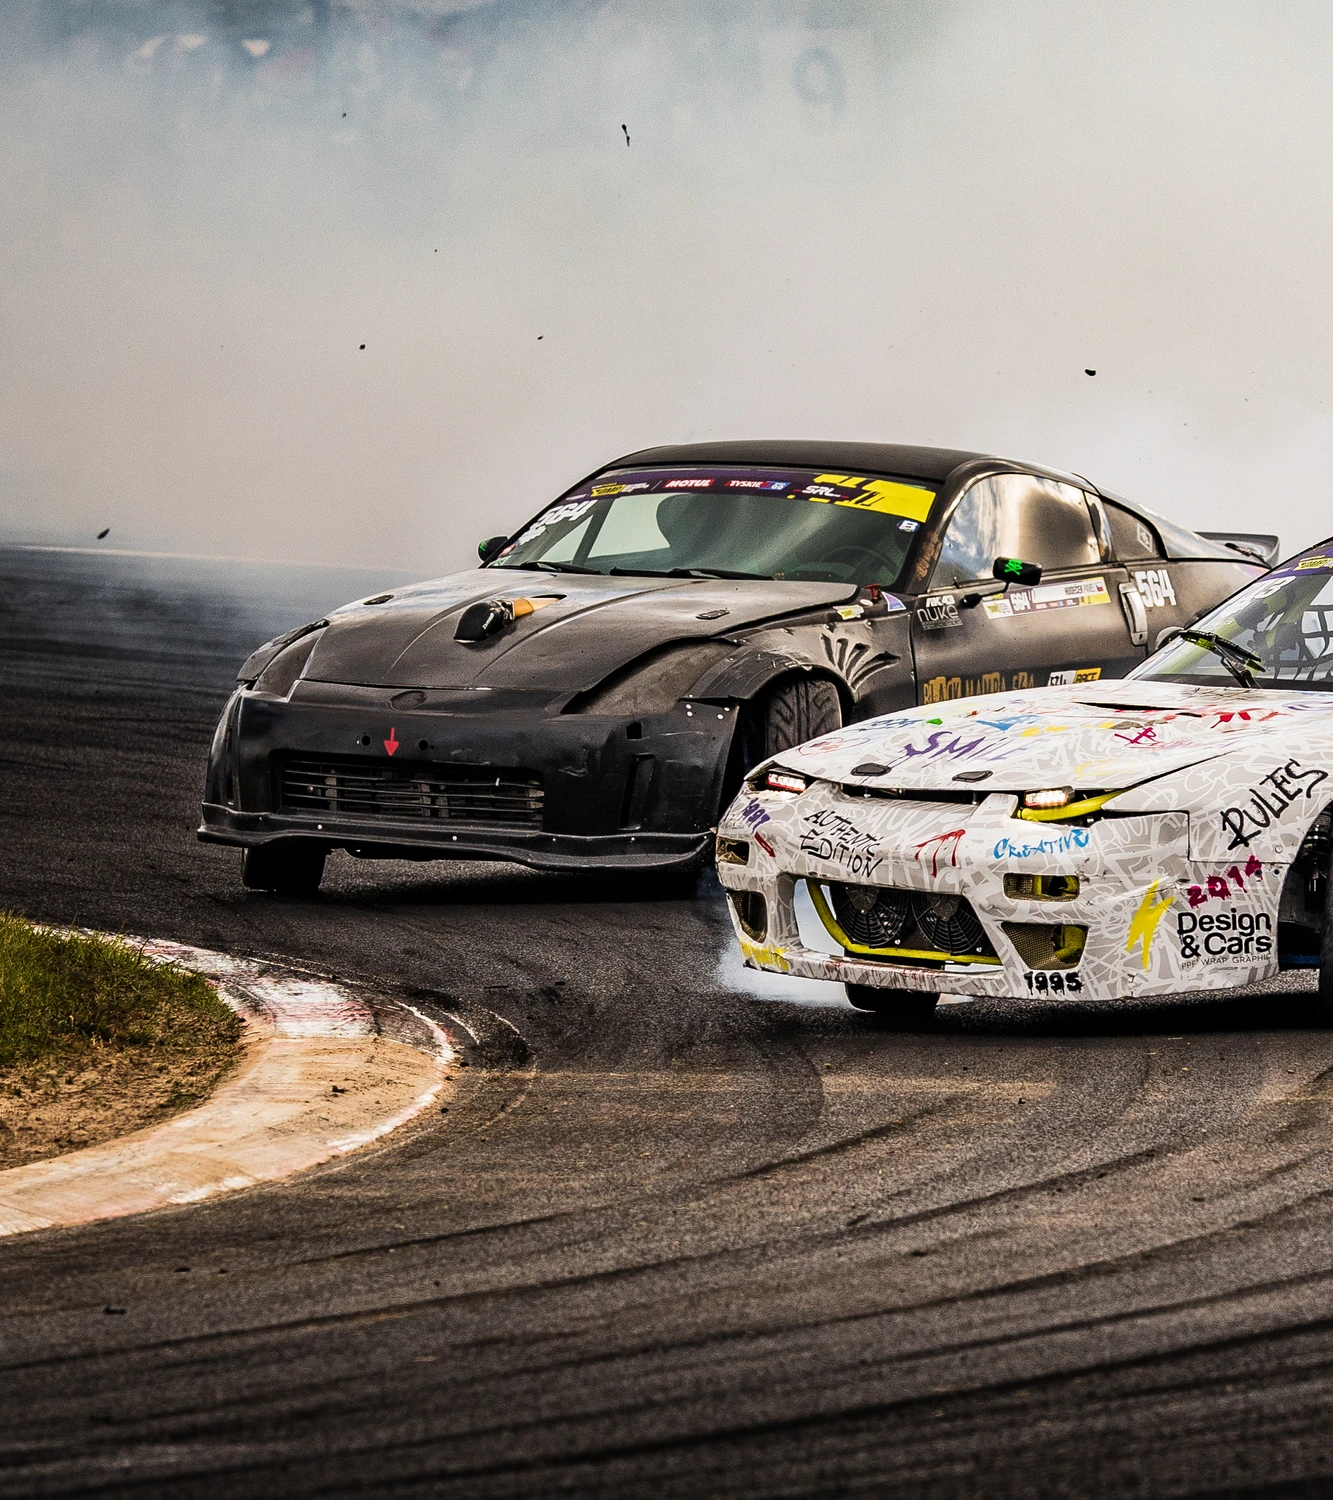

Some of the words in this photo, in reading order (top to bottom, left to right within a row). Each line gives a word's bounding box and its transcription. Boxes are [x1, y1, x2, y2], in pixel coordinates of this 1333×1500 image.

[666, 480, 711, 488] MOTUL
[729, 480, 763, 488] TYSKIE
[802, 486, 836, 497] SRL
[1135, 569, 1177, 607] 564
[917, 605, 959, 623] nuke
[1220, 758, 1329, 850] RULES
[804, 810, 884, 857] AUTHENTIC
[1177, 908, 1272, 937] Design
[1181, 935, 1201, 958] &
[1204, 932, 1272, 955] Cars
[1023, 970, 1085, 996] 1995
